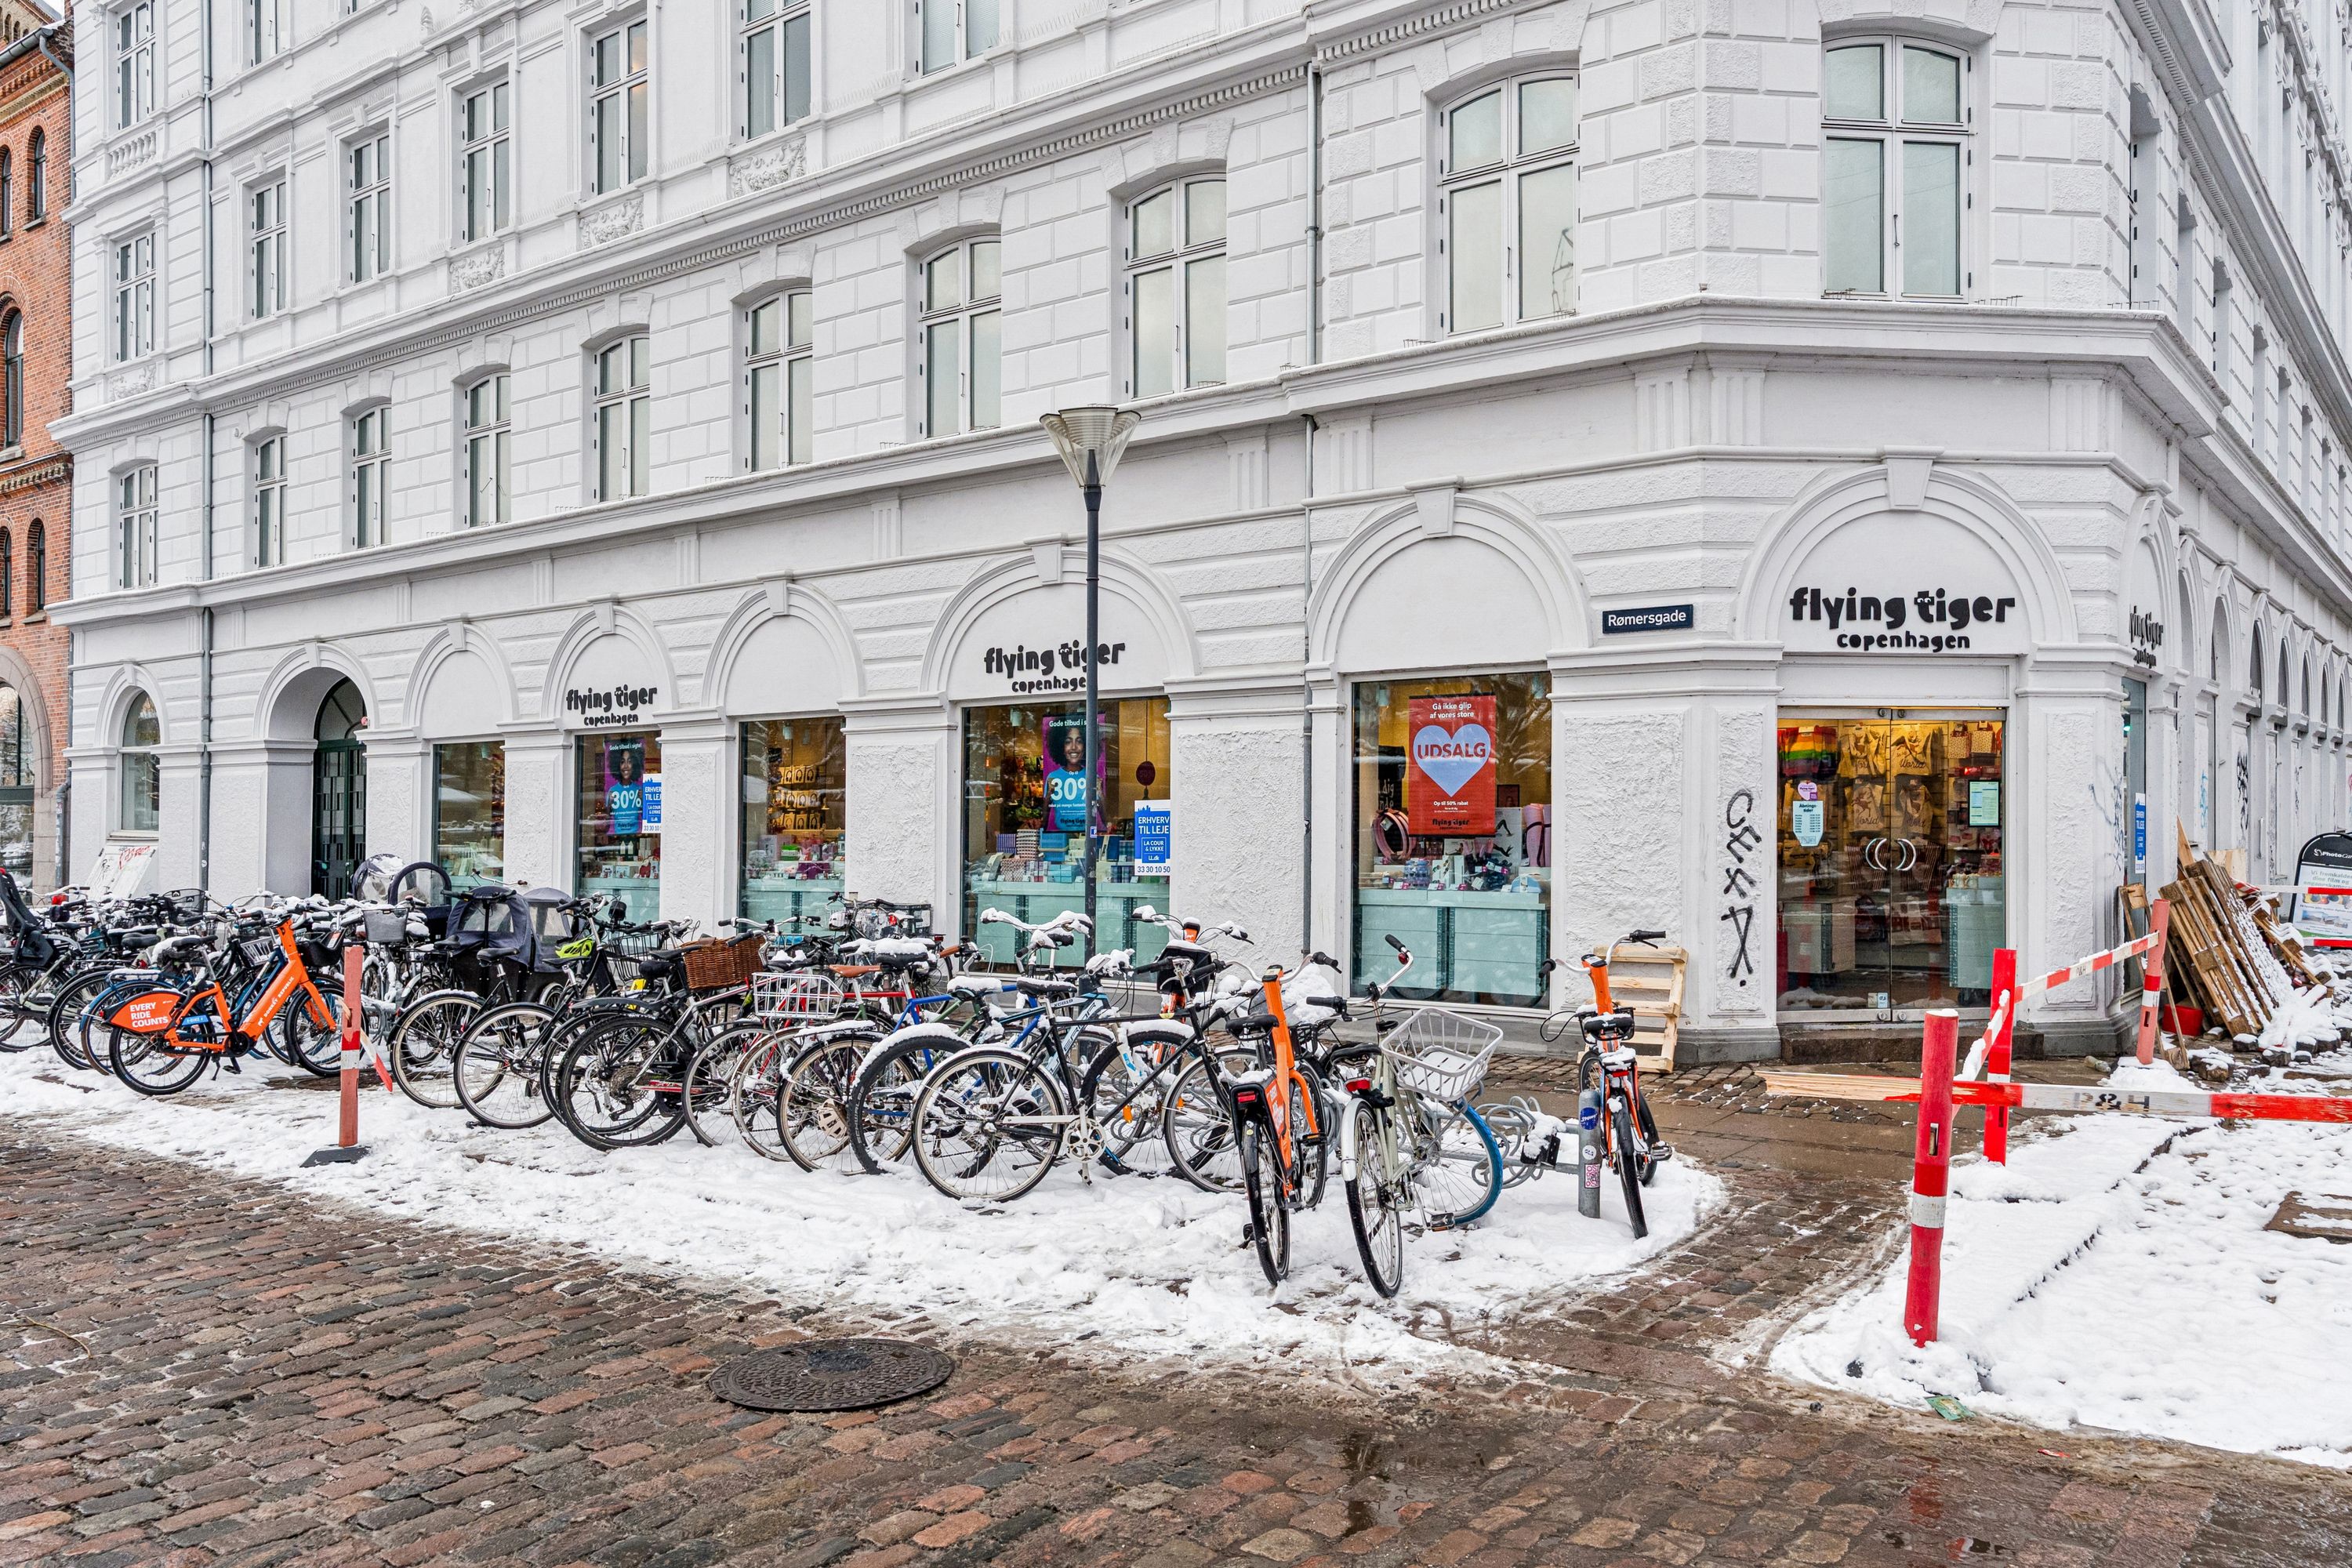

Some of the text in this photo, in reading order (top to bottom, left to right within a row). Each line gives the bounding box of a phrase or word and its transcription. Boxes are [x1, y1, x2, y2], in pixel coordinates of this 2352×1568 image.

[1789, 586, 2015, 630] flying tiger
[1608, 610, 1686, 626] Rømersgade
[1837, 630, 1970, 653] copenhagen
[984, 644, 1055, 679] flying
[1011, 676, 1087, 694] copenhage
[566, 684, 658, 714] flying tiger
[1458, 702, 1472, 710] glip
[584, 713, 639, 727] copenhagen
[1417, 742, 1486, 760] UDSALG
[612, 789, 642, 809] 30%
[1138, 825, 1169, 834] TIL LEJE
[129, 1002, 156, 1012] EVERY
[131, 1011, 151, 1019] RIDE
[132, 1016, 169, 1028] COUNTS
